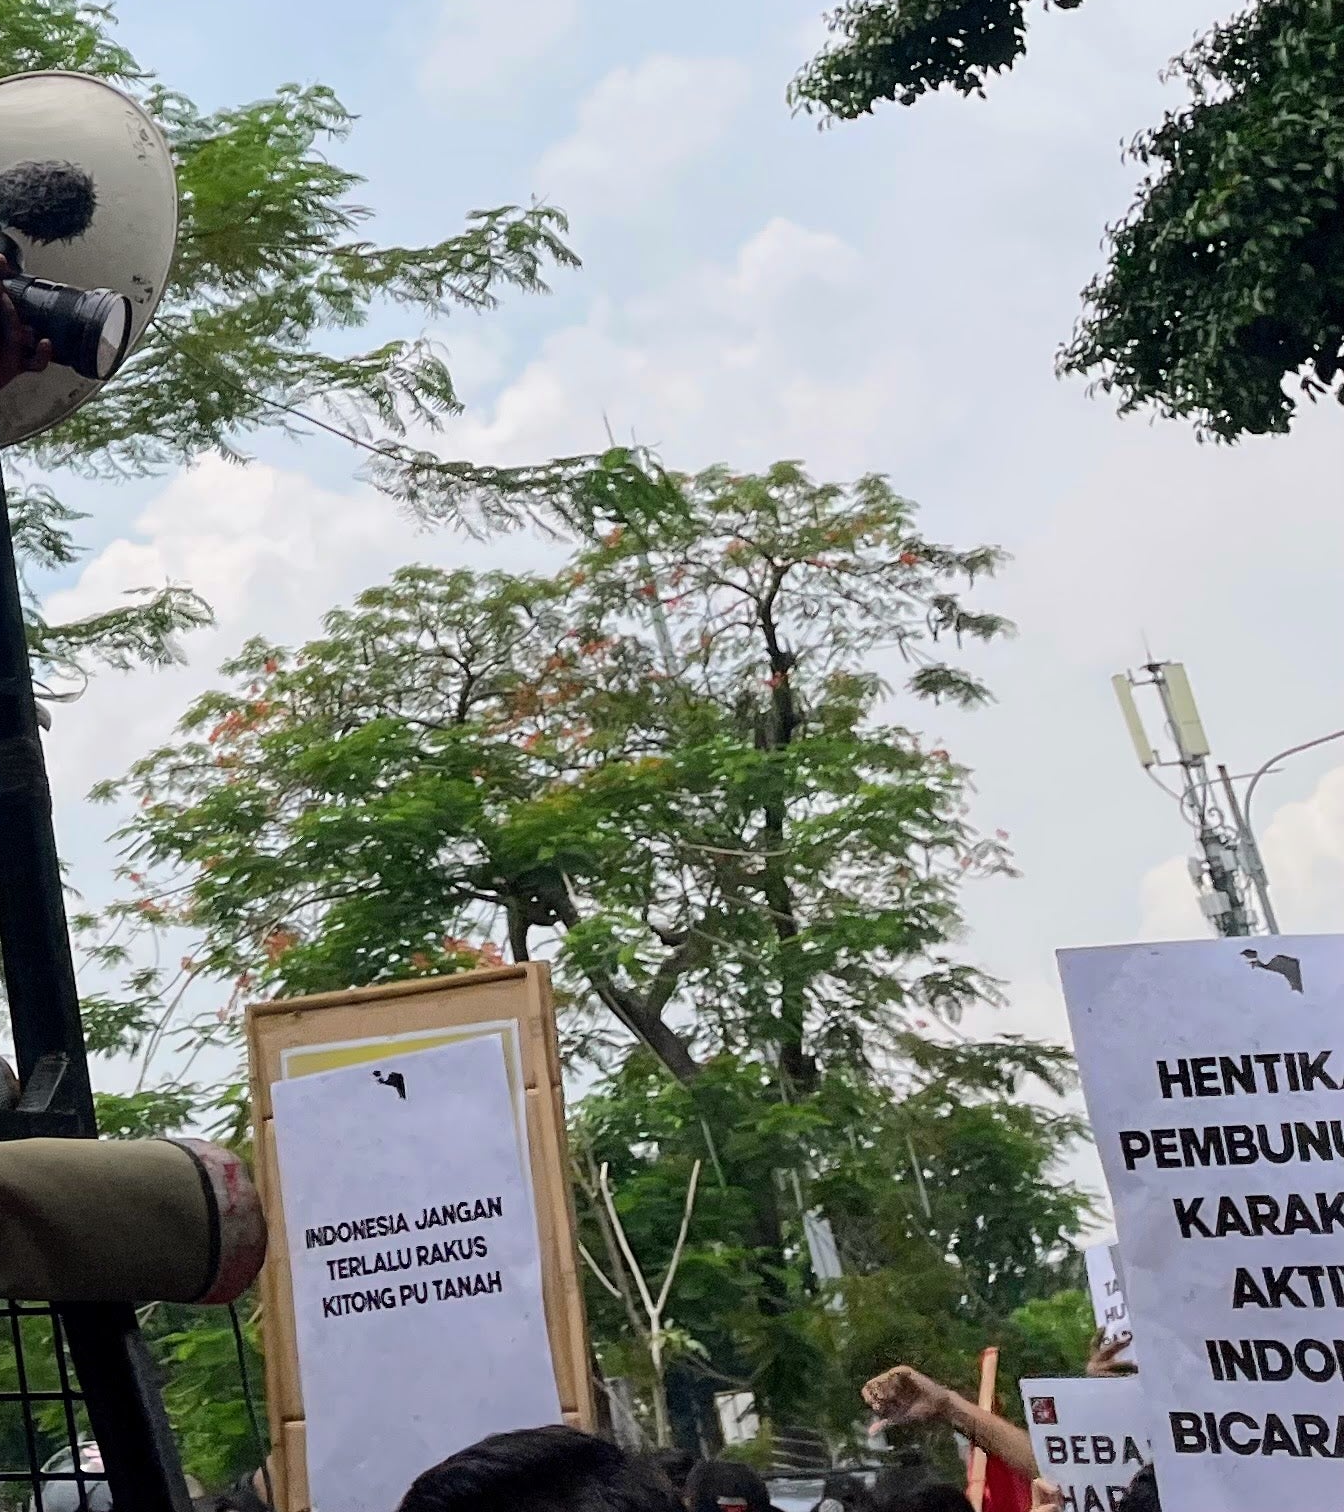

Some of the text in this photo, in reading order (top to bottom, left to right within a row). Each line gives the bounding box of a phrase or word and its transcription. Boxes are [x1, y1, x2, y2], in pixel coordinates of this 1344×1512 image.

[1156, 1050, 1344, 1099] HENTIK
[305, 1196, 503, 1249] INDONESIA JANGAN
[326, 1235, 489, 1281] TERLALU RAKUS
[322, 1270, 503, 1318] KITONG PU TANAH
[1205, 1338, 1344, 1383] INDO
[1045, 1435, 1151, 1465] BEBA
